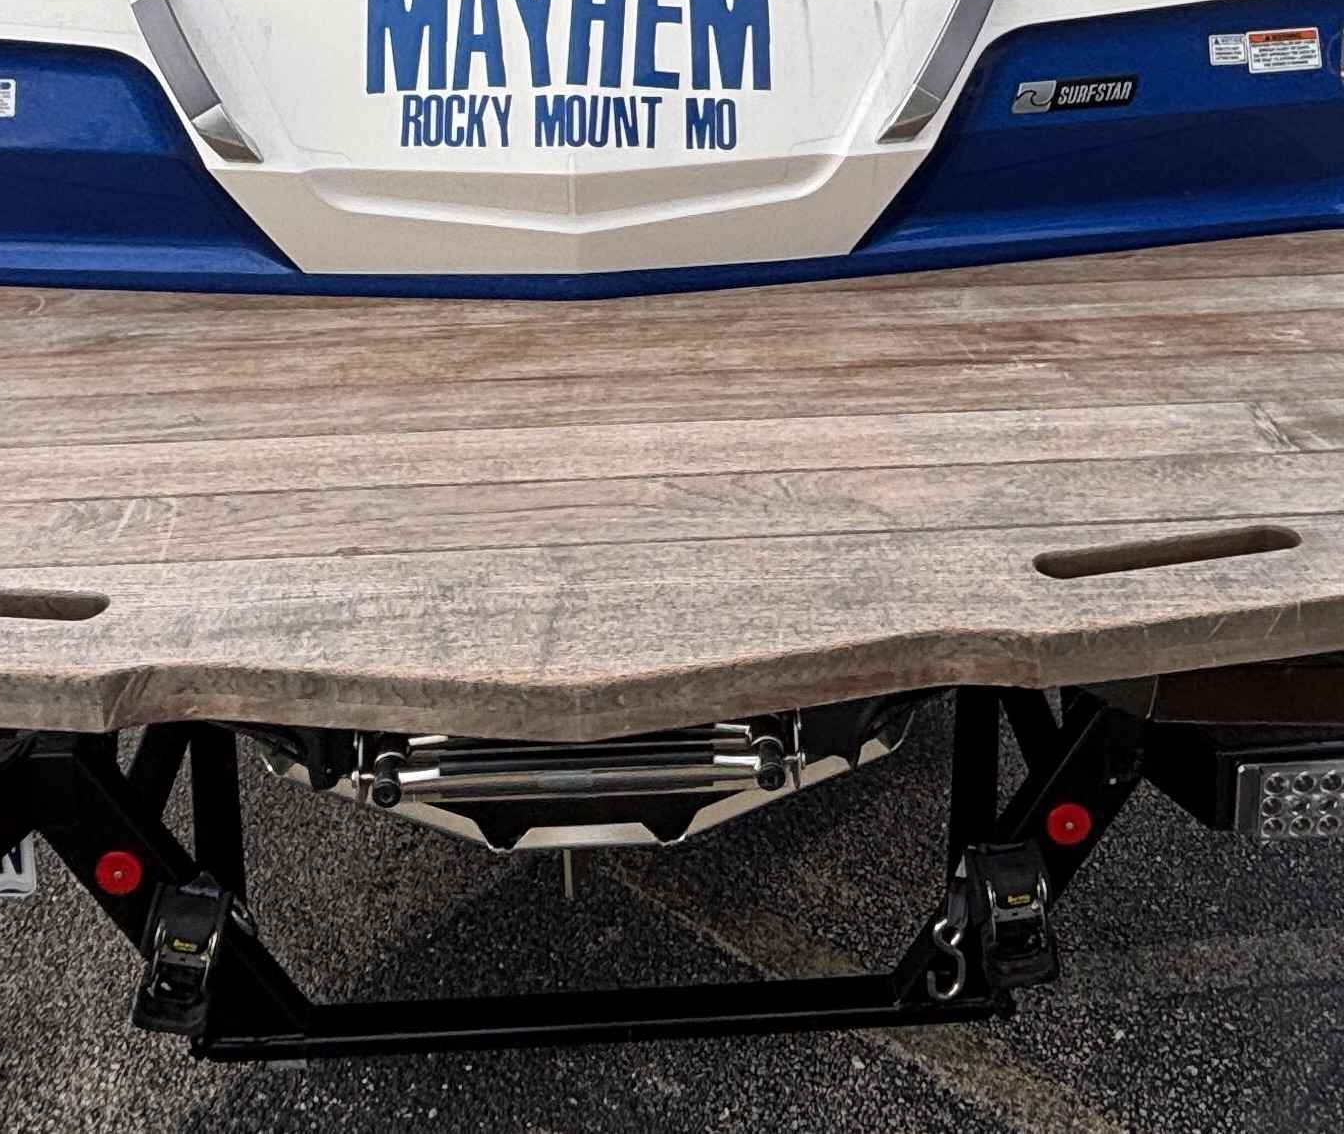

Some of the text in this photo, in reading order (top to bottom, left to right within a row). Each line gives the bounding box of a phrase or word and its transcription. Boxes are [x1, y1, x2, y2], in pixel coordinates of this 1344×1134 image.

[1057, 81, 1133, 105] SURFSTAR
[400, 94, 737, 151] ROCKY MOUNT MO
